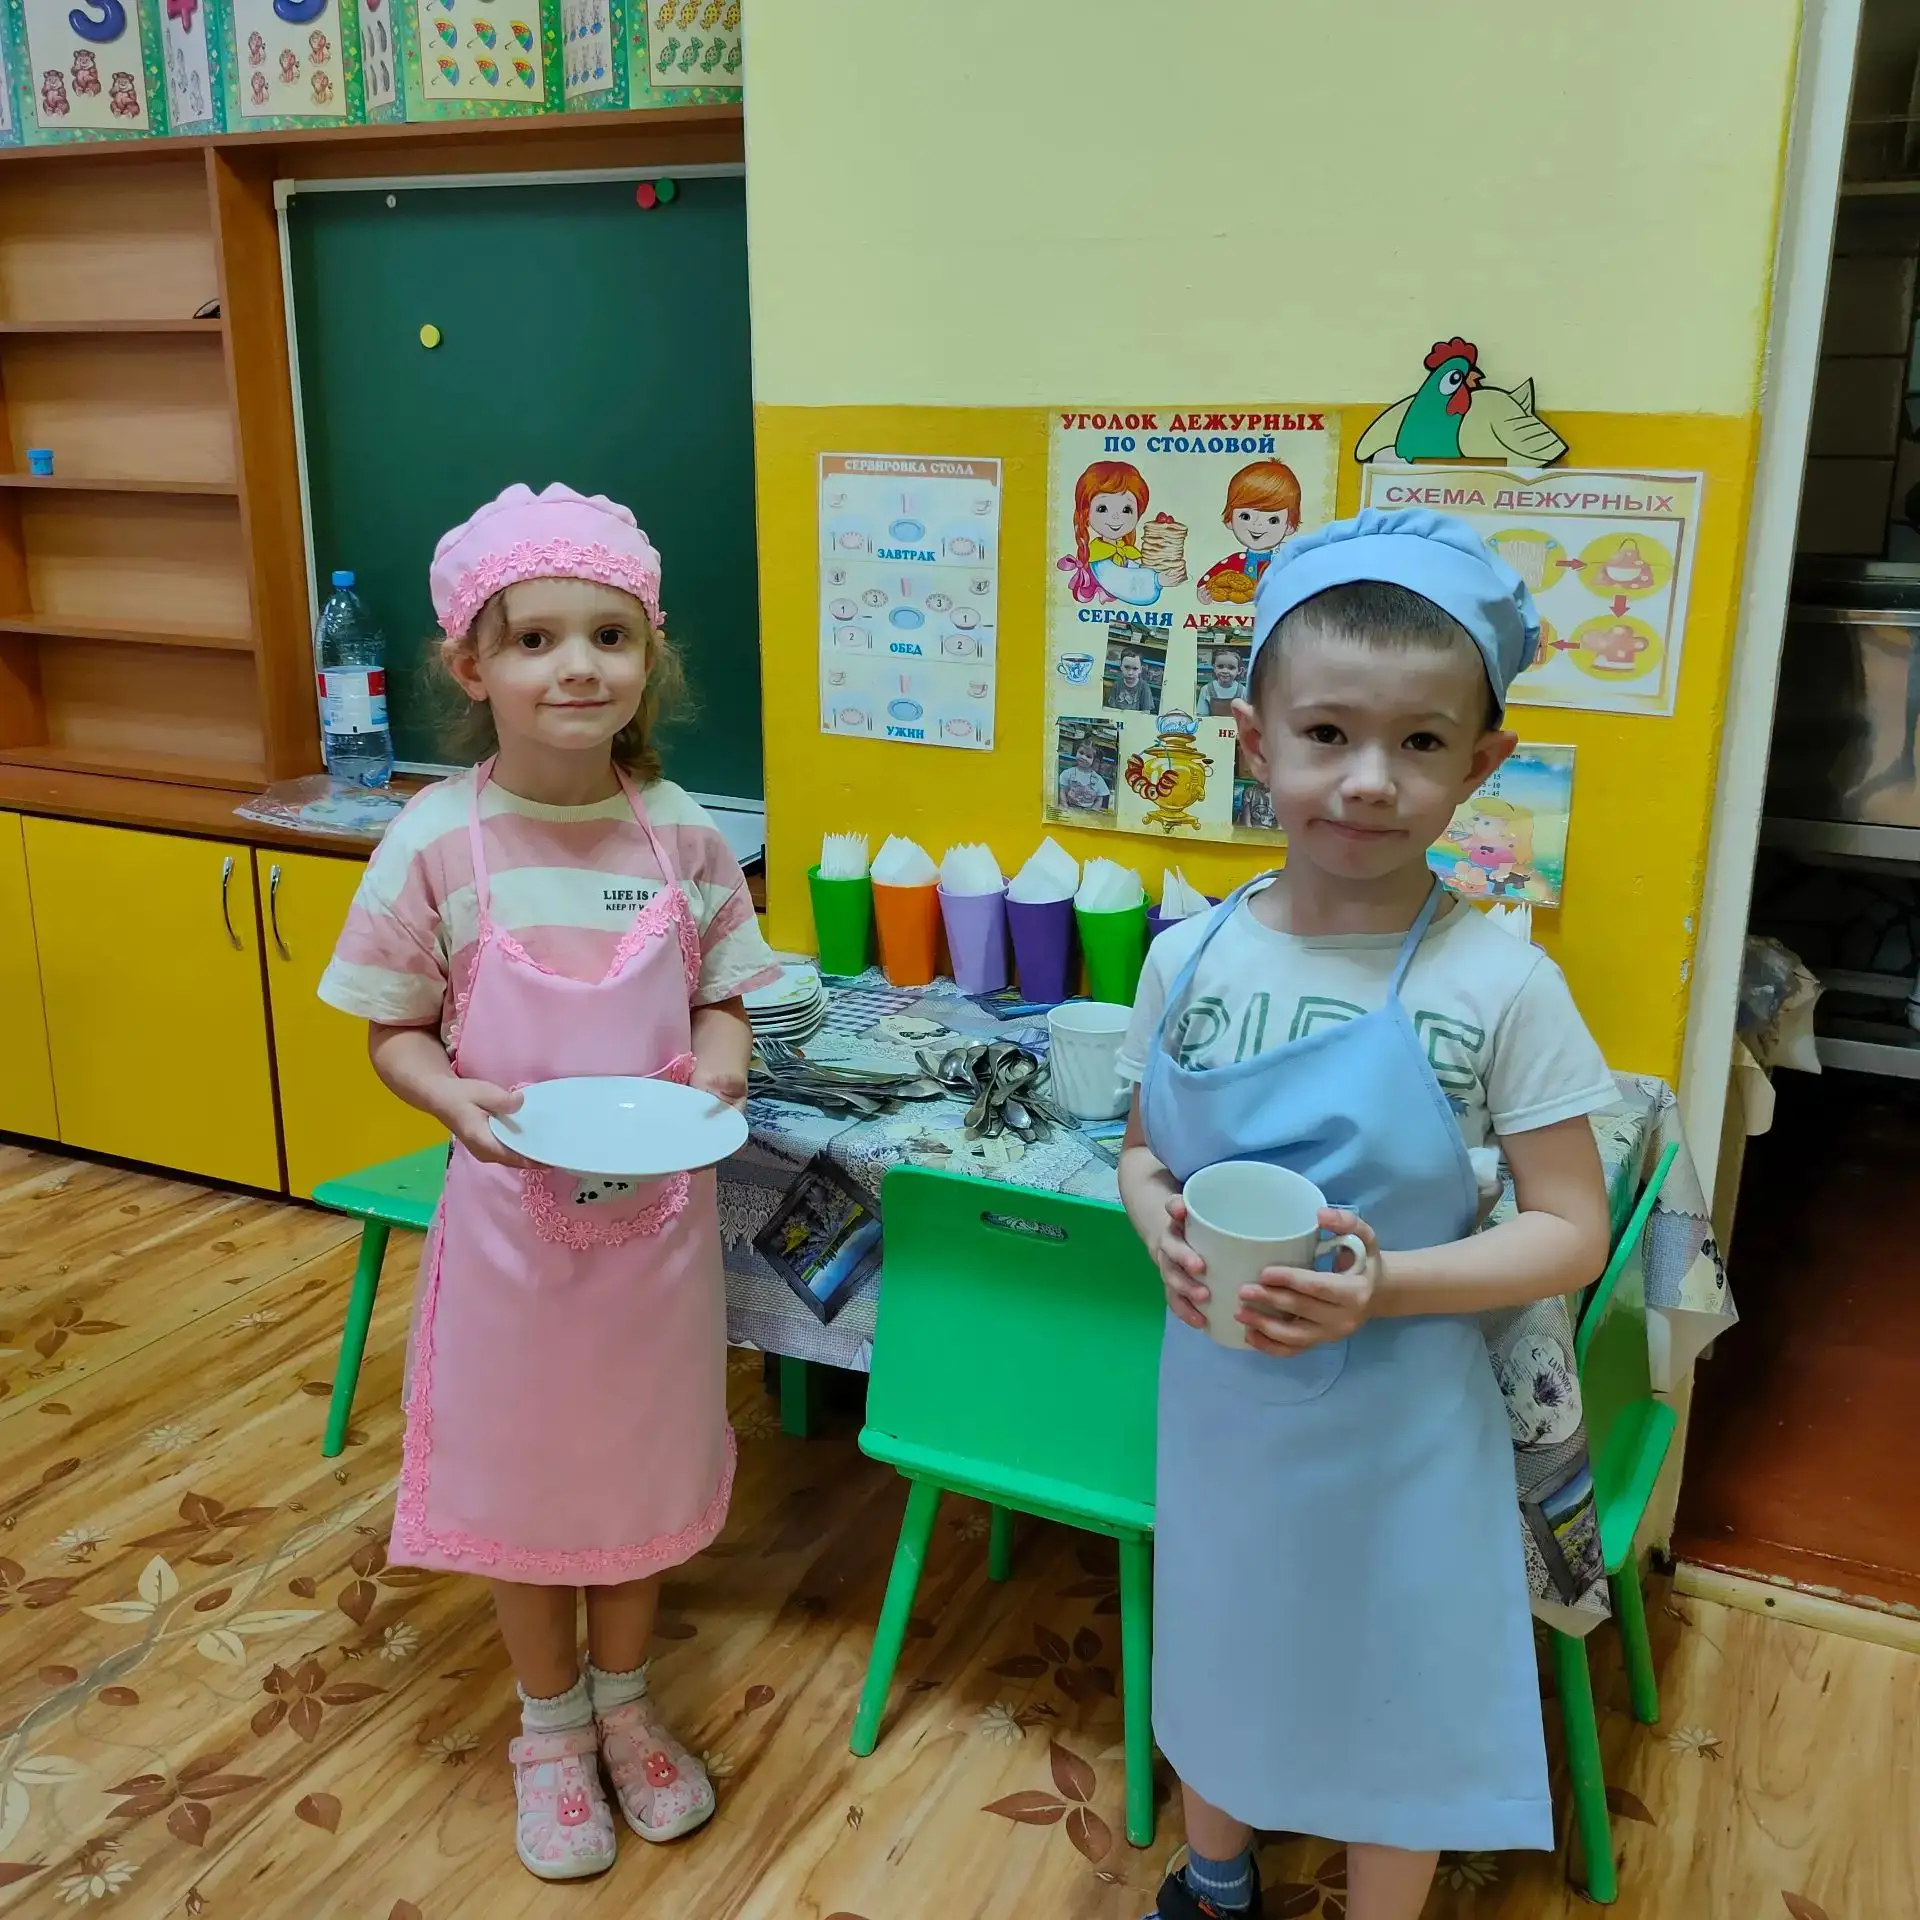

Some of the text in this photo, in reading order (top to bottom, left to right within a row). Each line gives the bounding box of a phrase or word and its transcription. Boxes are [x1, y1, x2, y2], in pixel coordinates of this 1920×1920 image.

[1061, 413, 1325, 433] УГОЛОК ДЕЖУРНЫХ
[1104, 433, 1276, 454] ПО СТОЛОВОЙ
[844, 459, 975, 476] СЕРВИРОВКА СТОЛА
[1385, 486, 1675, 513] СХЕМА ДЕЖУРНЫХ
[877, 548, 937, 562] ЗАВТРАК
[872, 594, 879, 604] 3
[936, 599, 942, 608] 3
[1078, 608, 1174, 627] СЕГОДНЯ
[849, 632, 855, 641] 2
[889, 642, 923, 656] ОБЕД
[957, 641, 963, 650] 2
[886, 725, 925, 740] УЖИН
[603, 890, 634, 901] LIFE
[636, 890, 649, 901] IS
[606, 903, 627, 911] KEEP
[629, 903, 637, 911] IT
